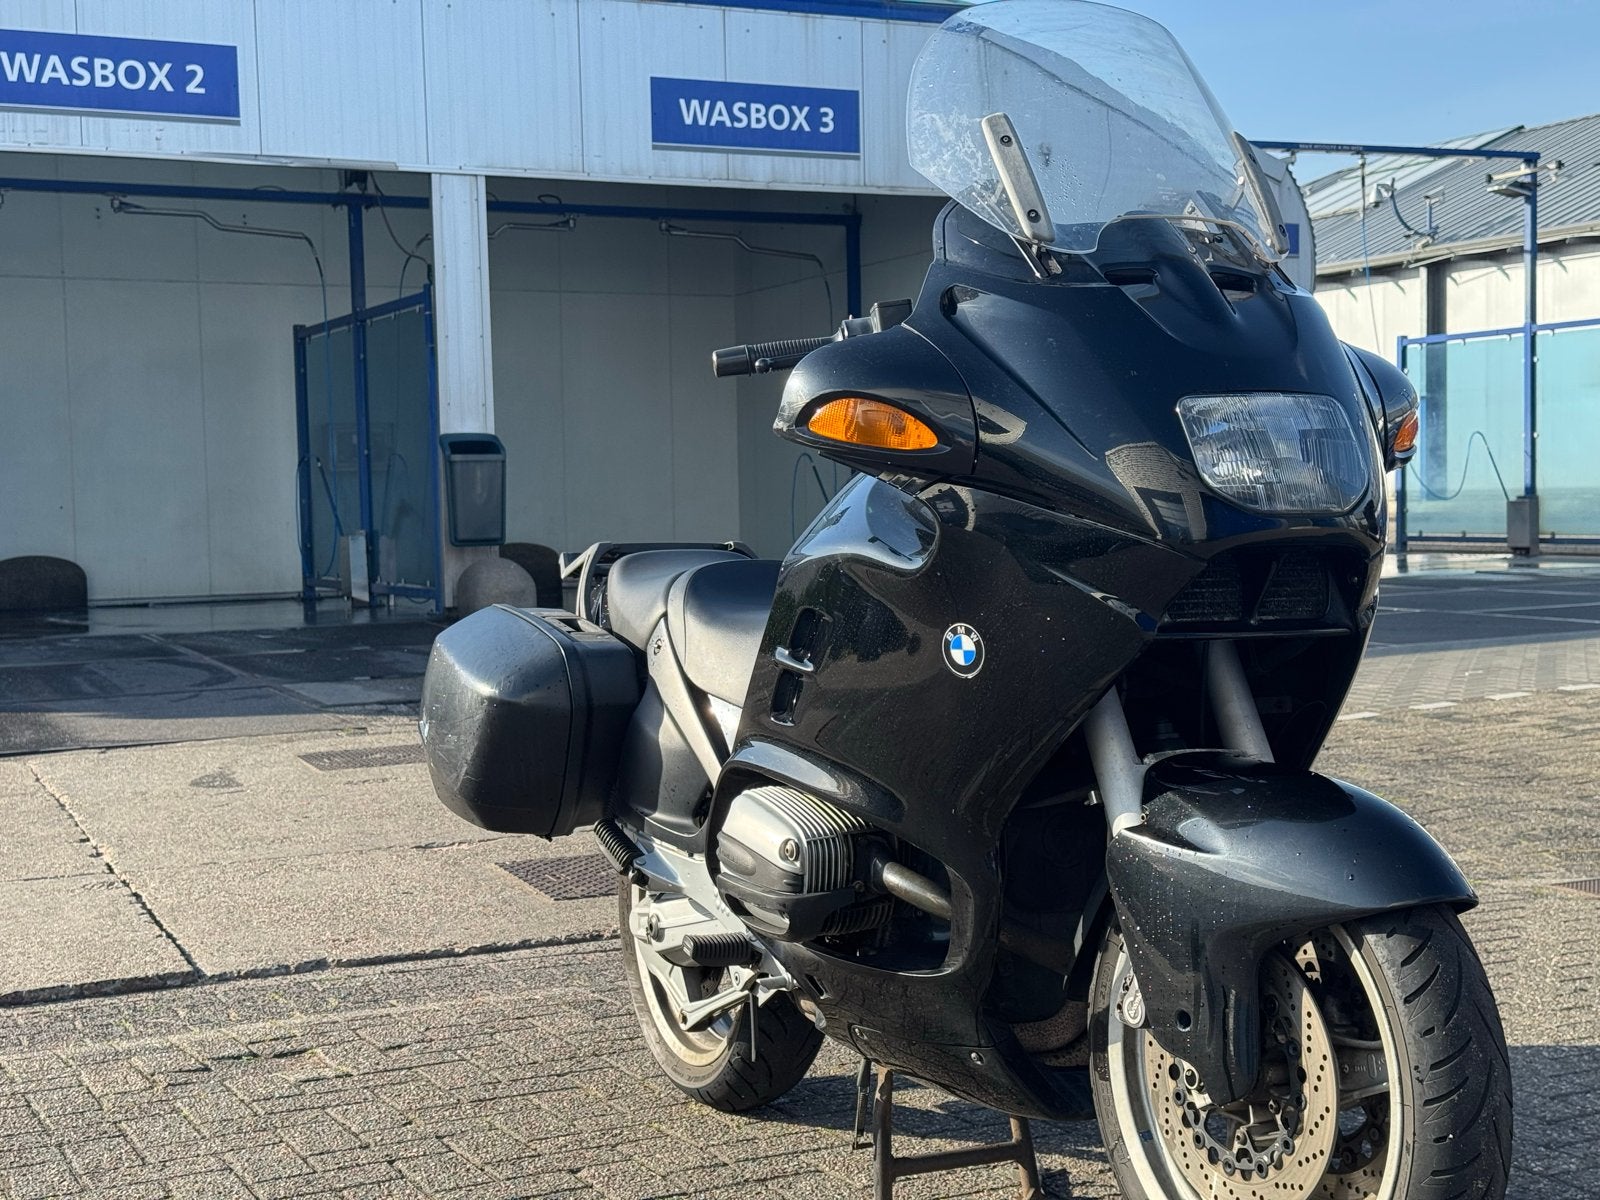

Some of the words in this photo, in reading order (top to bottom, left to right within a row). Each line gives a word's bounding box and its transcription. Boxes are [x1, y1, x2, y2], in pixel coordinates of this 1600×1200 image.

[0, 51, 175, 92] WASBOX
[185, 64, 206, 94] 2
[679, 98, 811, 132] WASBOX
[819, 107, 835, 133] 3
[946, 626, 979, 642] BMW
